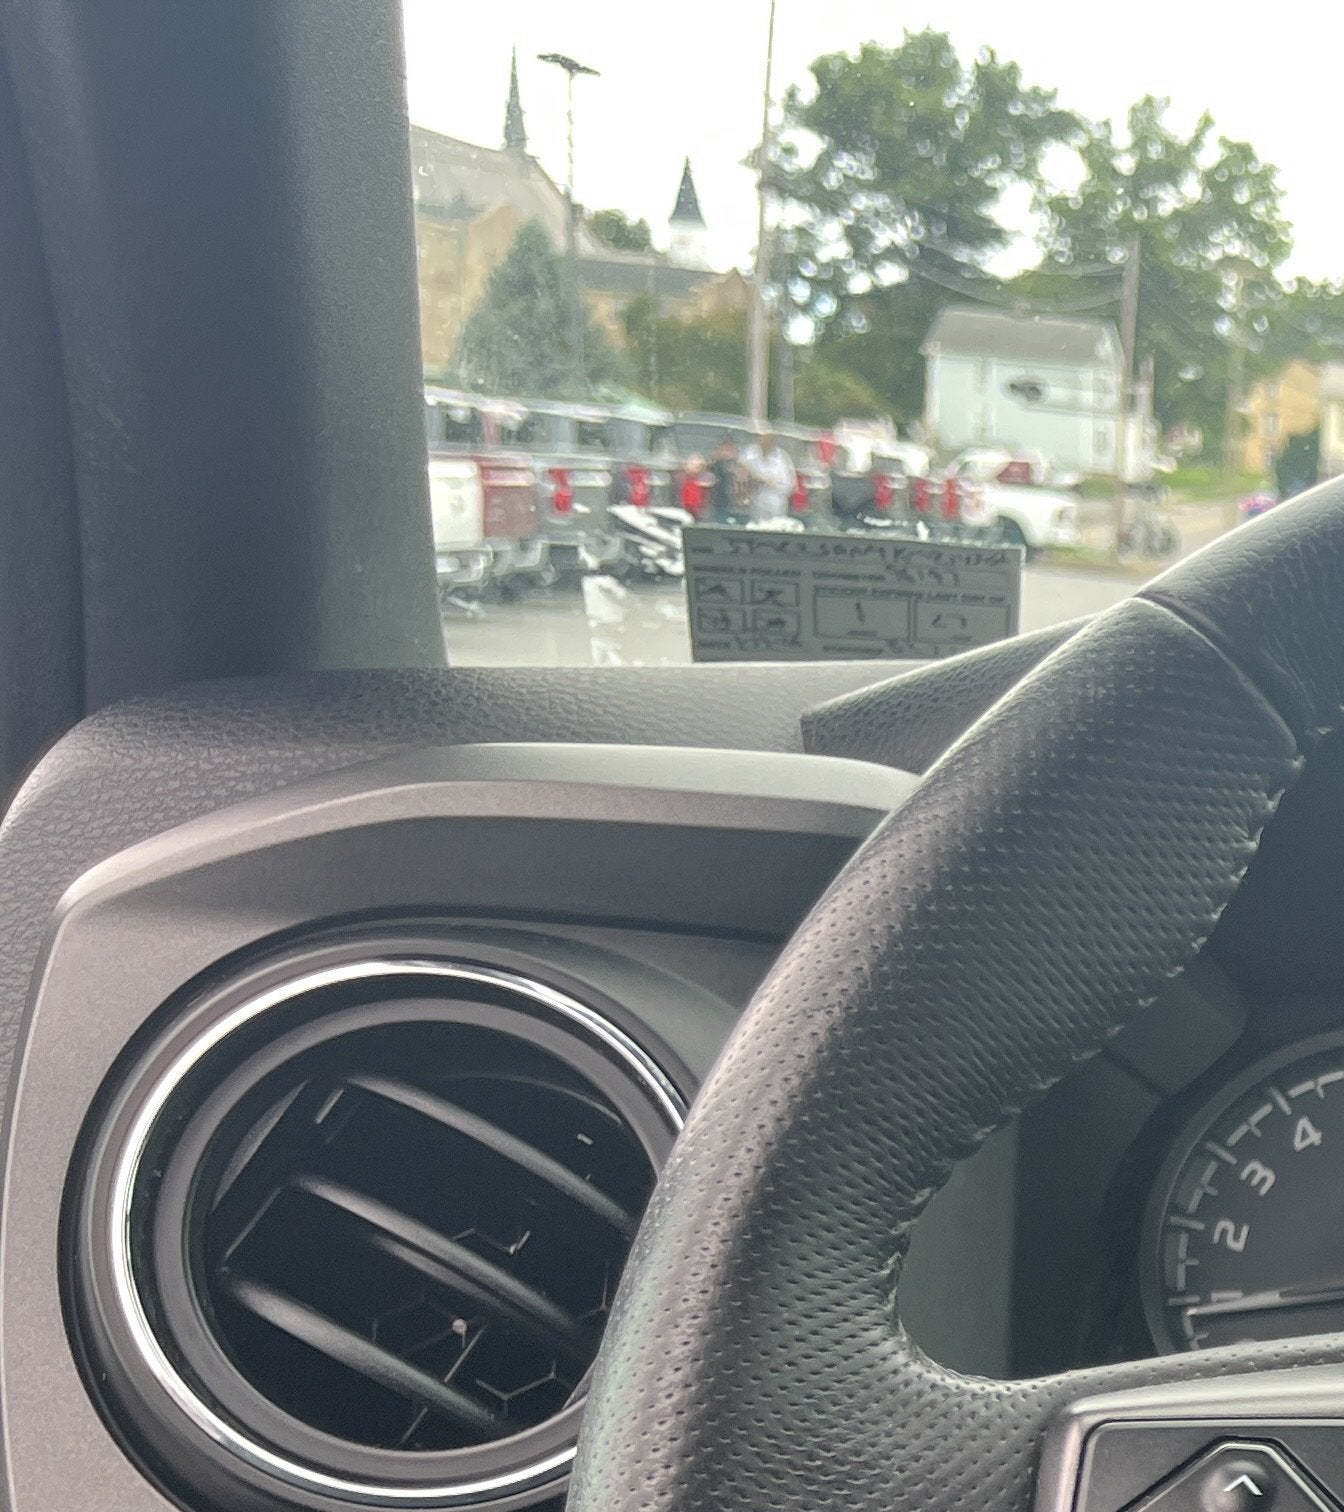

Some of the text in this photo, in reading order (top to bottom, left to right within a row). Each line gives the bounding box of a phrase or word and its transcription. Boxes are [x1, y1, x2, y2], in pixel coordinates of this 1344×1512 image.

[1293, 1116, 1322, 1153] 4
[1240, 1161, 1276, 1196] 3
[1213, 1219, 1249, 1252] 2
